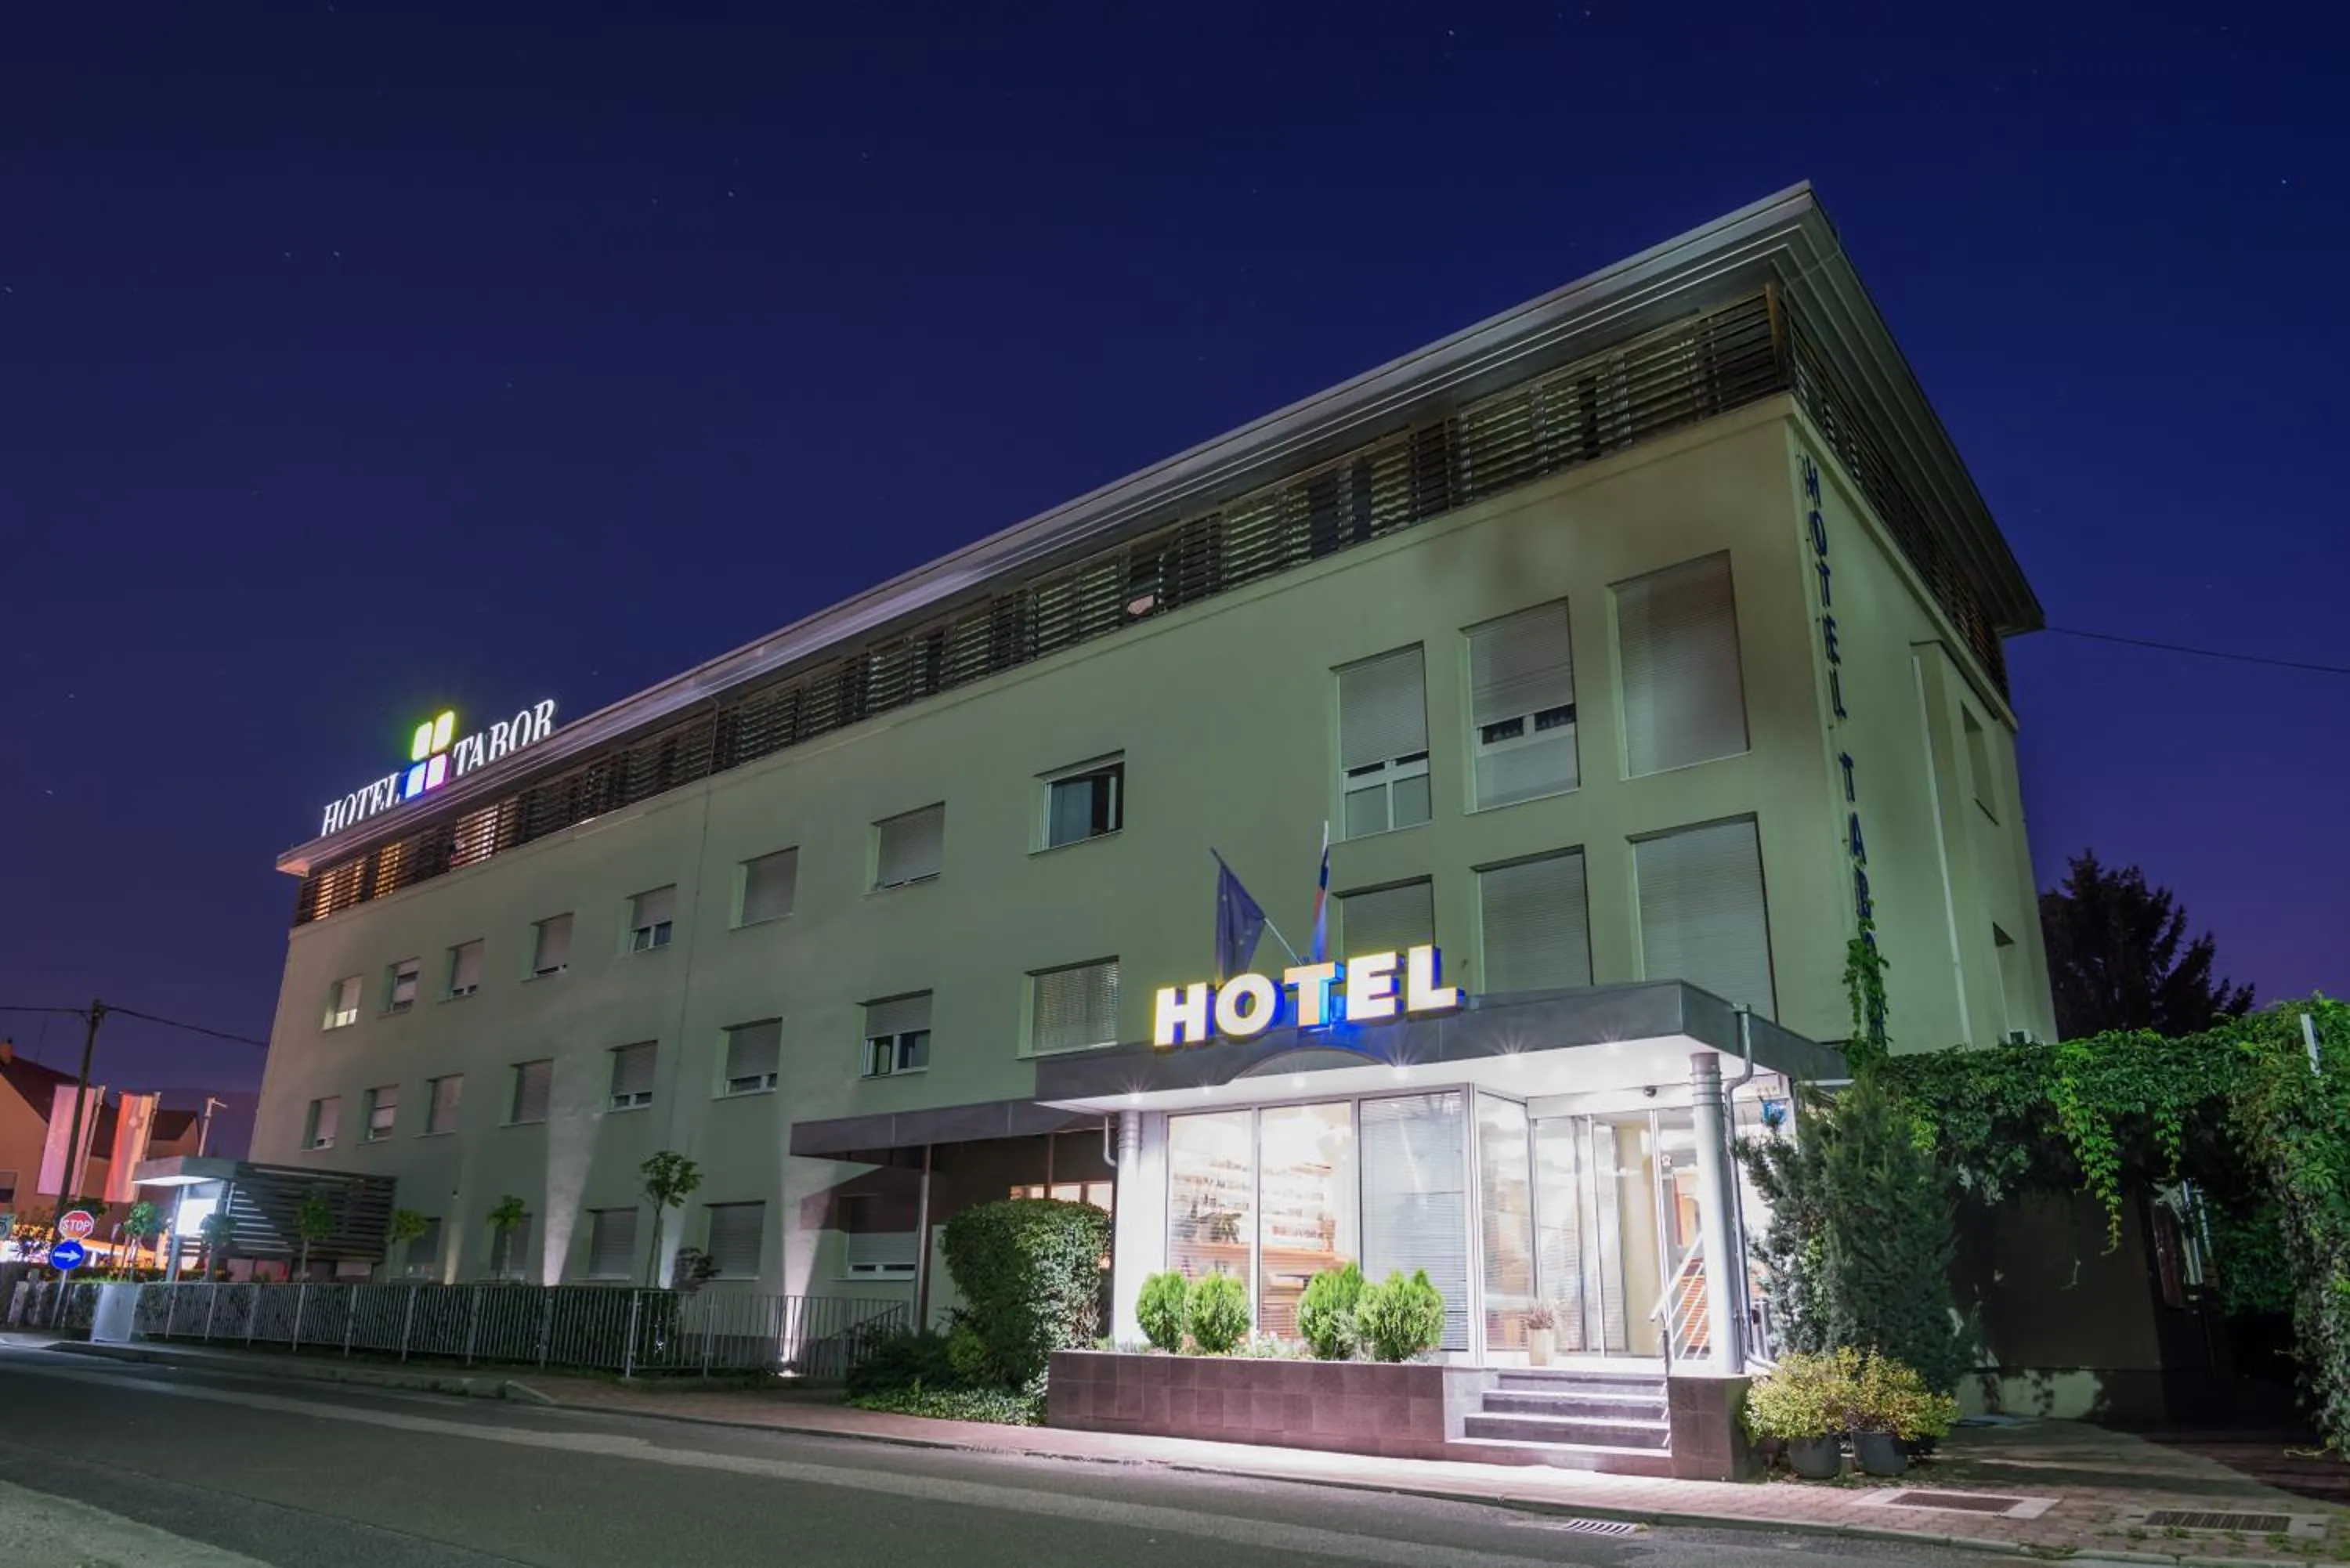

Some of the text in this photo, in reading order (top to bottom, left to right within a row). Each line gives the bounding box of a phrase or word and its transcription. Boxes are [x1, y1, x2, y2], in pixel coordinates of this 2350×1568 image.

[1804, 454, 1847, 720] HOTEL
[321, 699, 555, 837] HOTEL TABOR
[1154, 944, 1463, 1047] HOTEL
[63, 1219, 90, 1232] STOP
